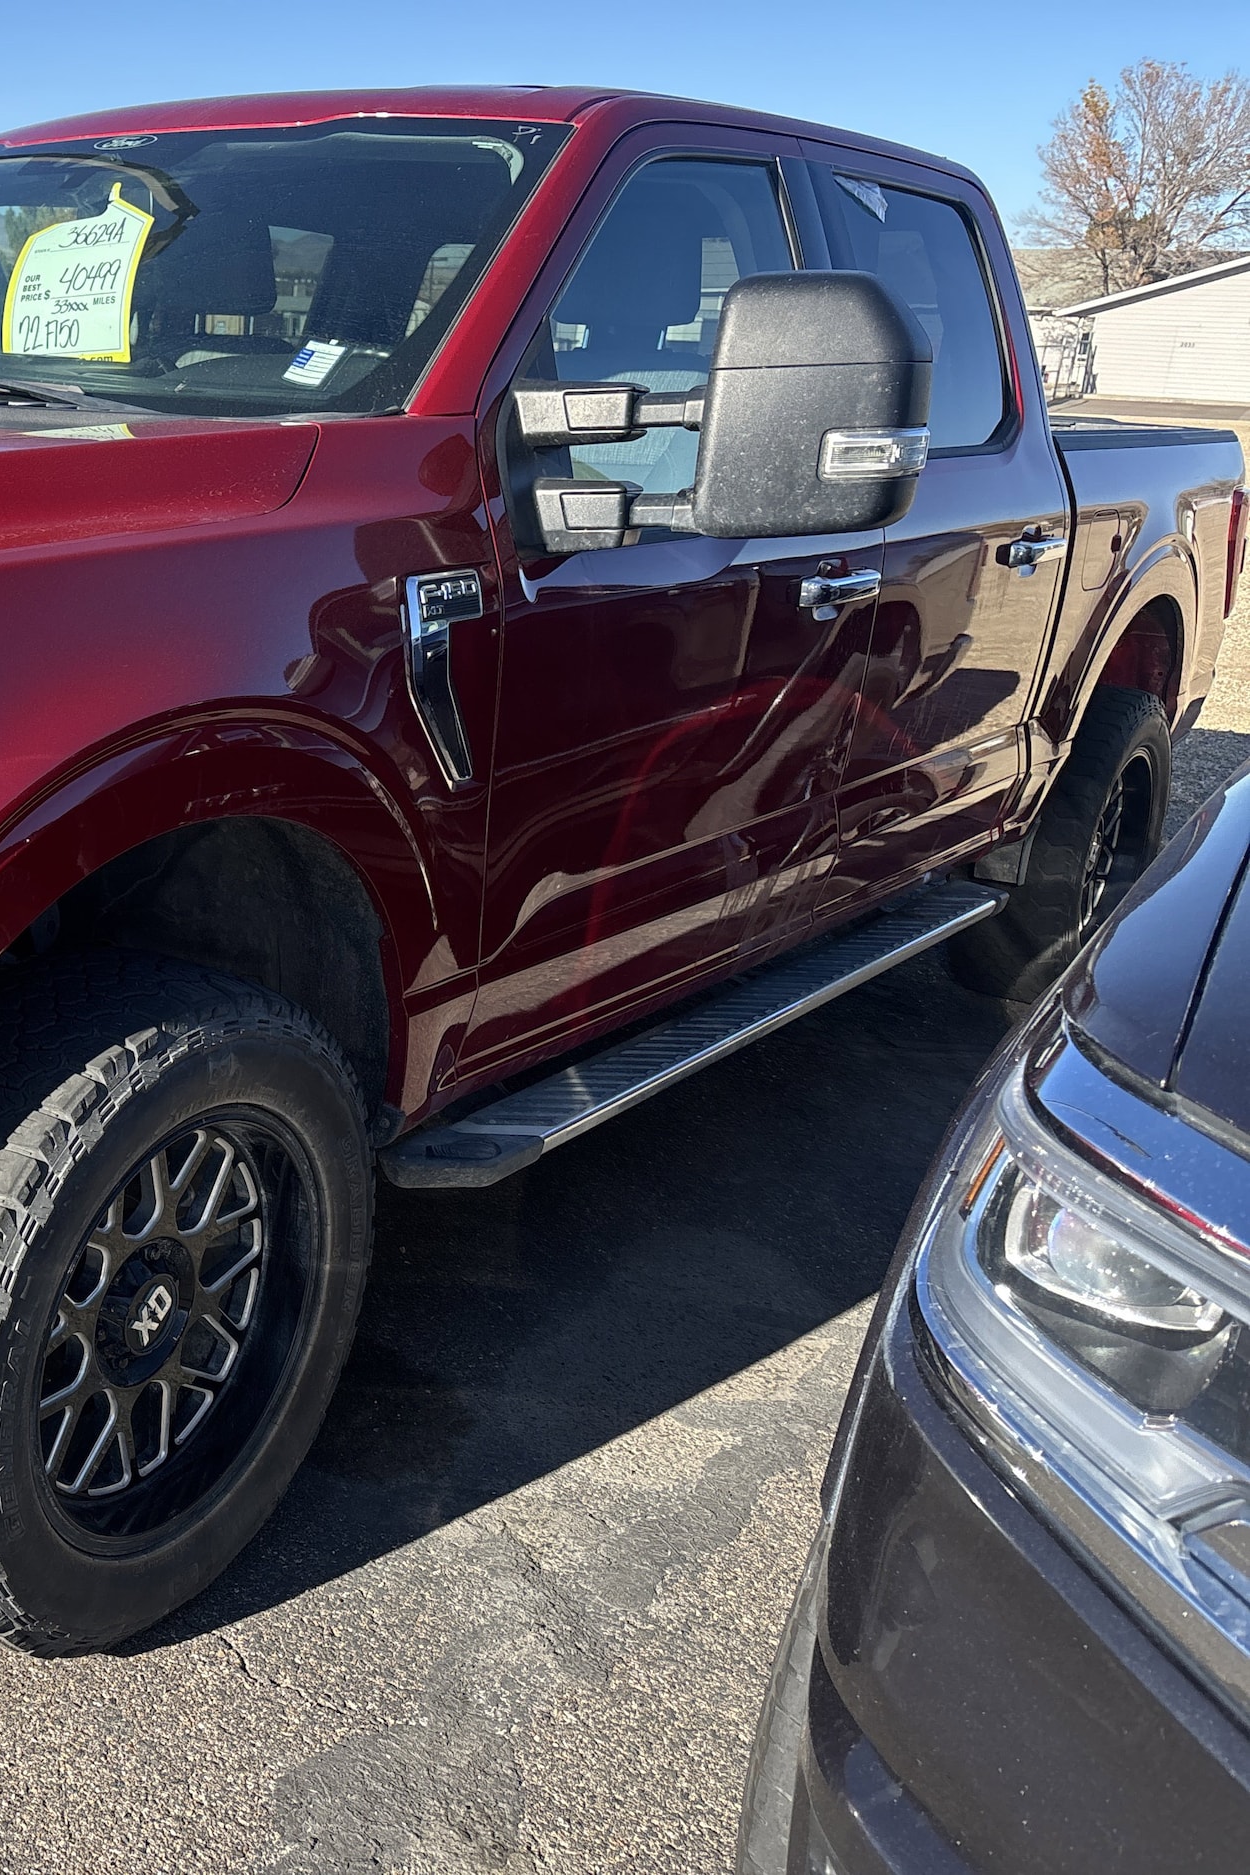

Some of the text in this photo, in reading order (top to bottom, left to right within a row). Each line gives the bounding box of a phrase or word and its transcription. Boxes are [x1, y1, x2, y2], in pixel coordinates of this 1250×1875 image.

[101, 136, 148, 148] Ford
[58, 217, 126, 248] 36629A
[20, 258, 121, 303] PRICE $ 40499
[22, 283, 42, 292] BEST
[25, 274, 41, 283] OUR
[92, 295, 116, 306] MILES
[19, 315, 80, 352] 22 F150
[131, 1285, 173, 1348] XD
